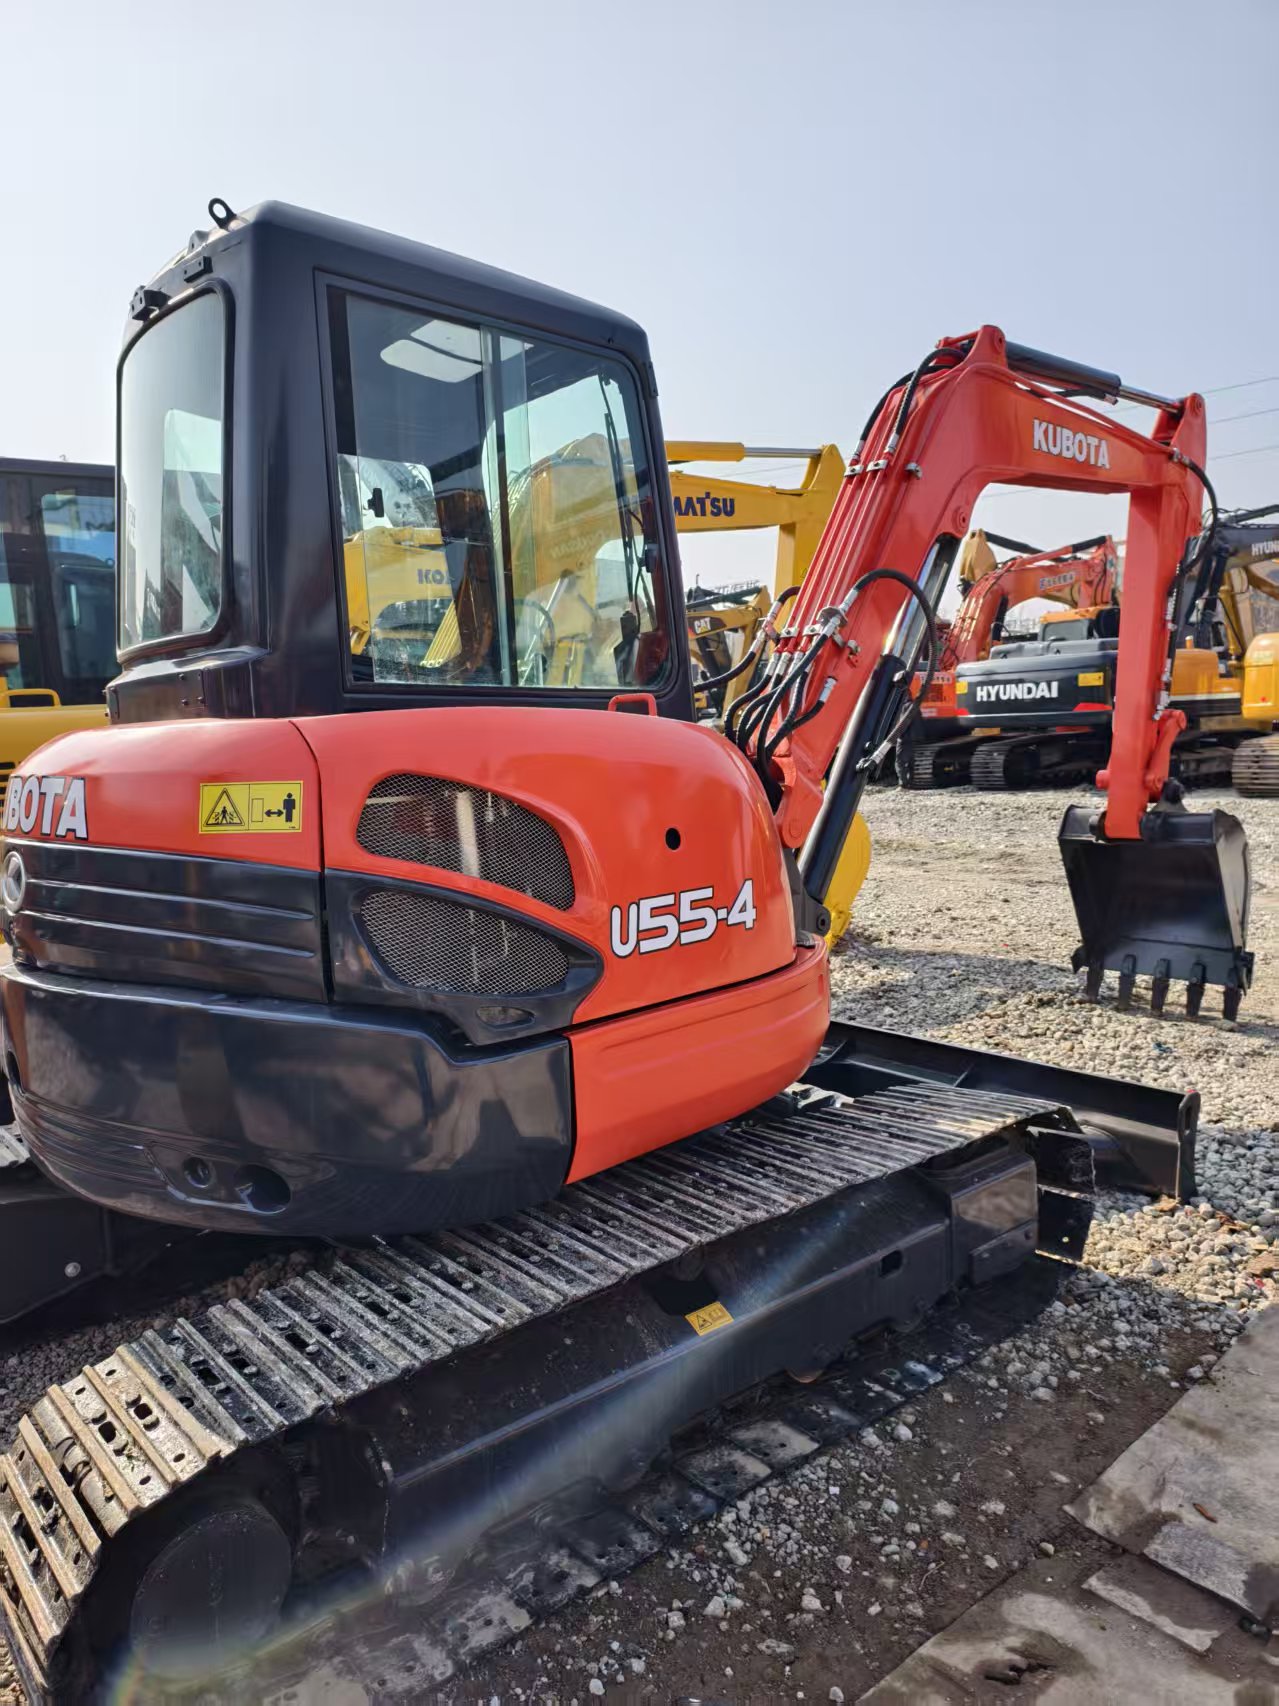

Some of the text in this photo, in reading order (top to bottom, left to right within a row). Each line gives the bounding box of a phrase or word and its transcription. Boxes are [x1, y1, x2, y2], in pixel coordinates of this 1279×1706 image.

[1032, 417, 1111, 469] KUBOTA
[694, 617, 711, 634] CAT
[976, 681, 1059, 702] HYUNDAI
[610, 878, 757, 959] U55-4
